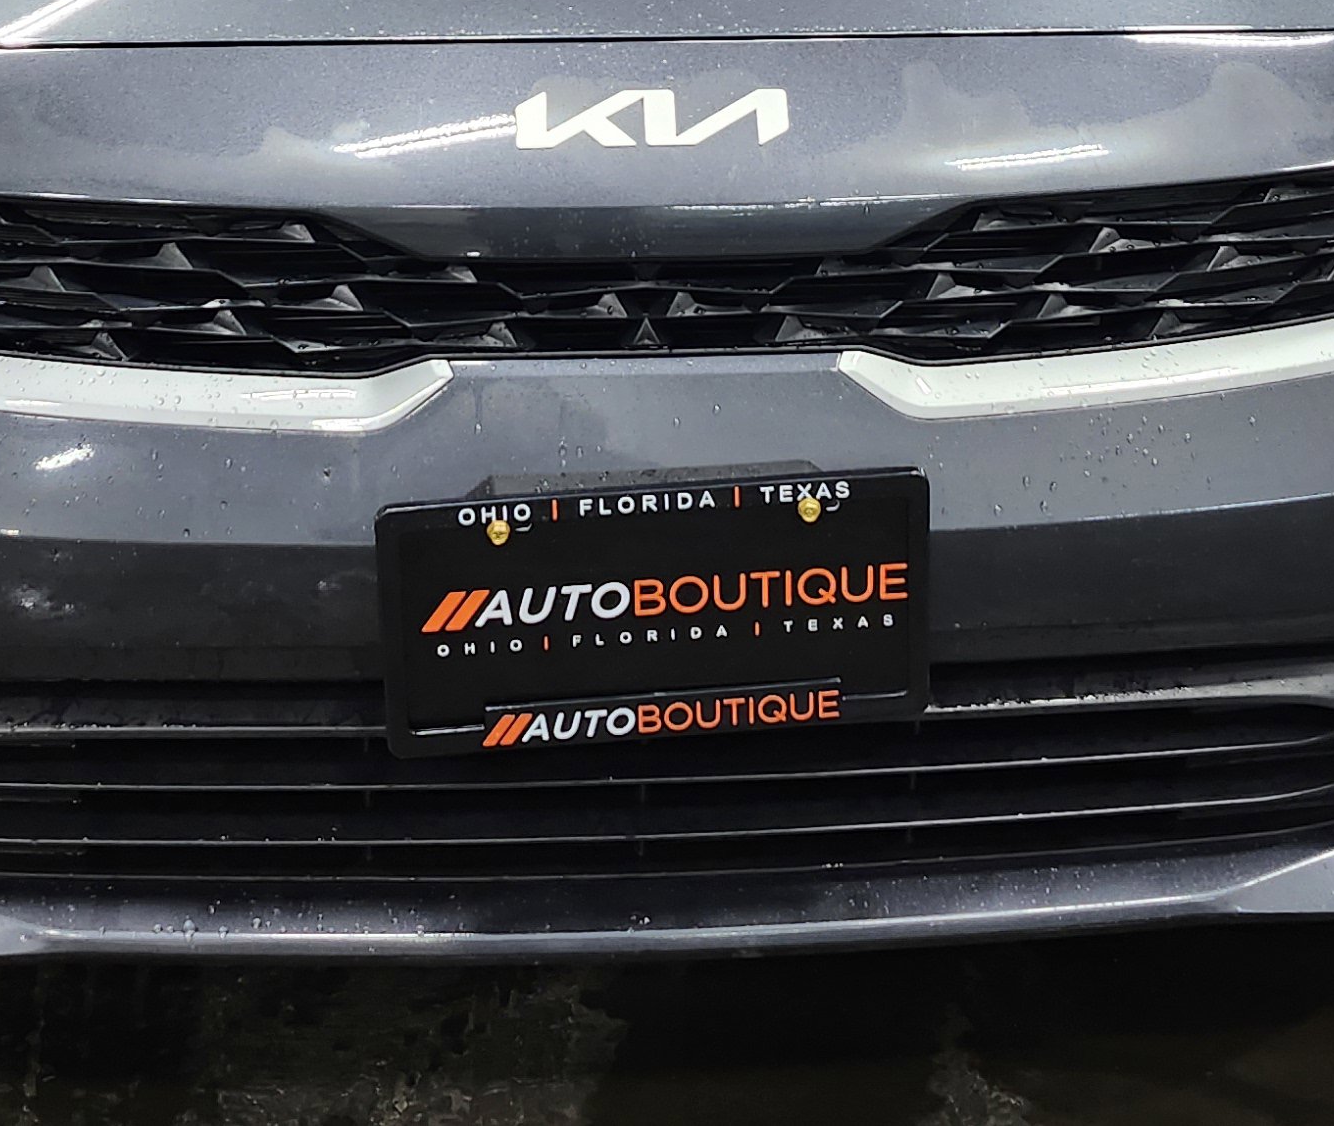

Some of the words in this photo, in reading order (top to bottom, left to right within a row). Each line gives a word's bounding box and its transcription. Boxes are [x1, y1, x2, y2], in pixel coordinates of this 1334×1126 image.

[514, 88, 790, 150] KIA
[458, 503, 531, 526] OHIO
[579, 490, 716, 517] FLORIDA
[759, 480, 850, 505] TEXAS
[475, 562, 908, 628] AUTOBOUTIQUE
[437, 639, 523, 657] OHIO
[572, 624, 728, 648] FLORIDA
[783, 613, 894, 633] TEXAS
[521, 689, 840, 743] AUTOBOUTIQUE
